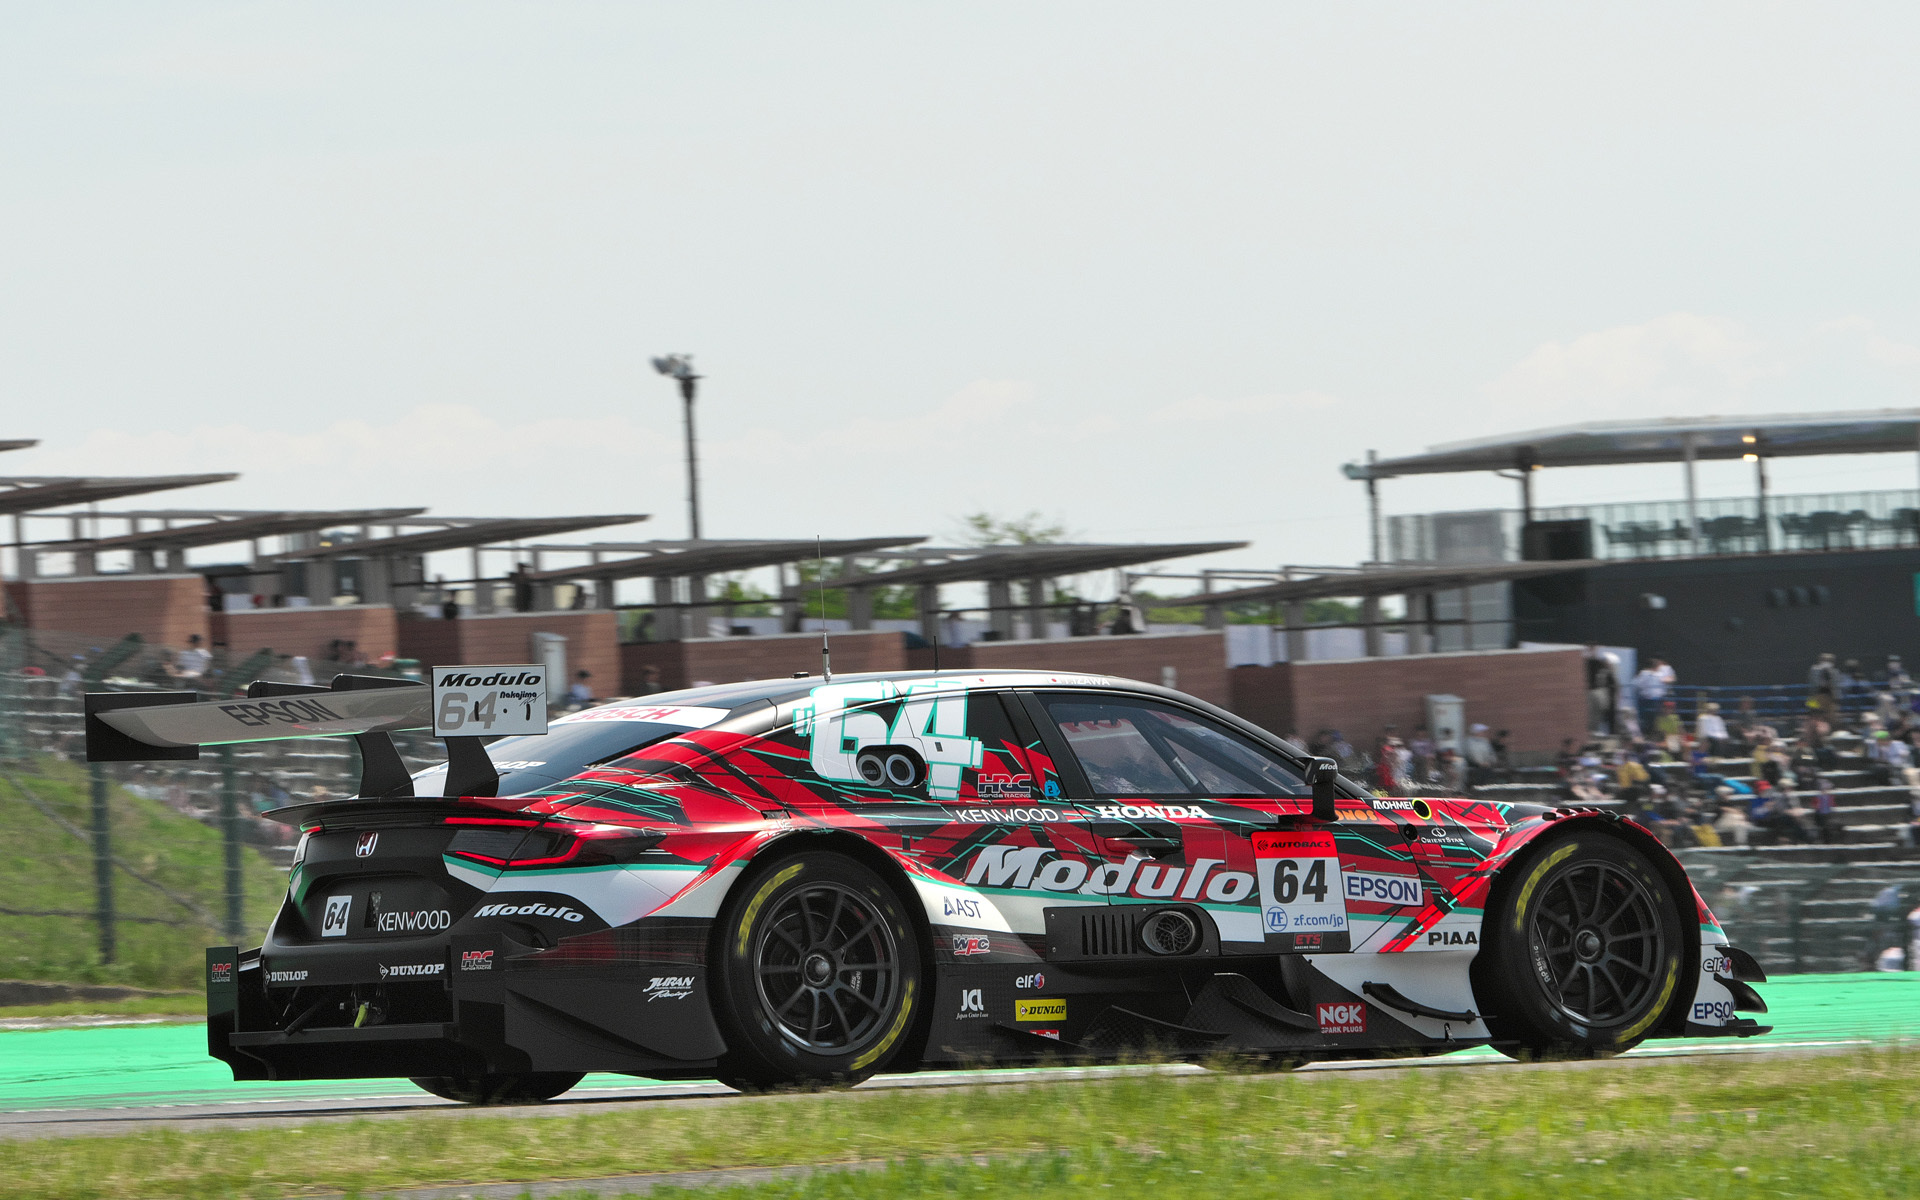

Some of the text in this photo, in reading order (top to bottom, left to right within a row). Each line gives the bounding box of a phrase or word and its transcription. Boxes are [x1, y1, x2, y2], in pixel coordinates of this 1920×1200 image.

[439, 671, 541, 687] Modulo
[500, 691, 537, 700] Nakajima
[218, 699, 344, 726] EPSON
[438, 692, 498, 730] 64
[793, 681, 983, 800] 64
[977, 773, 1031, 793] HRC
[956, 808, 1059, 823] KENWOOD
[1095, 805, 1213, 819] HONDA
[1270, 840, 1331, 848] AUTOBACS
[964, 845, 1255, 901] Modulo
[1273, 859, 1327, 904] 64
[1347, 875, 1418, 902] EPSON
[324, 902, 349, 930] 64
[474, 903, 584, 922] Modulo
[1268, 911, 1344, 928] ZF zf.com/jp
[377, 910, 450, 932] KENWOOD
[1295, 934, 1321, 945] ETS
[1428, 931, 1478, 945] PIAA
[390, 964, 445, 976] DUNLOP
[1702, 957, 1724, 972] elf
[271, 970, 308, 981] DUNLOP
[1015, 974, 1034, 989] elf
[643, 976, 695, 992] JURAN
[1029, 1005, 1065, 1015] DUNLOP
[1320, 1005, 1362, 1025] NGK
[1343, 1025, 1363, 1033] PLUGS
